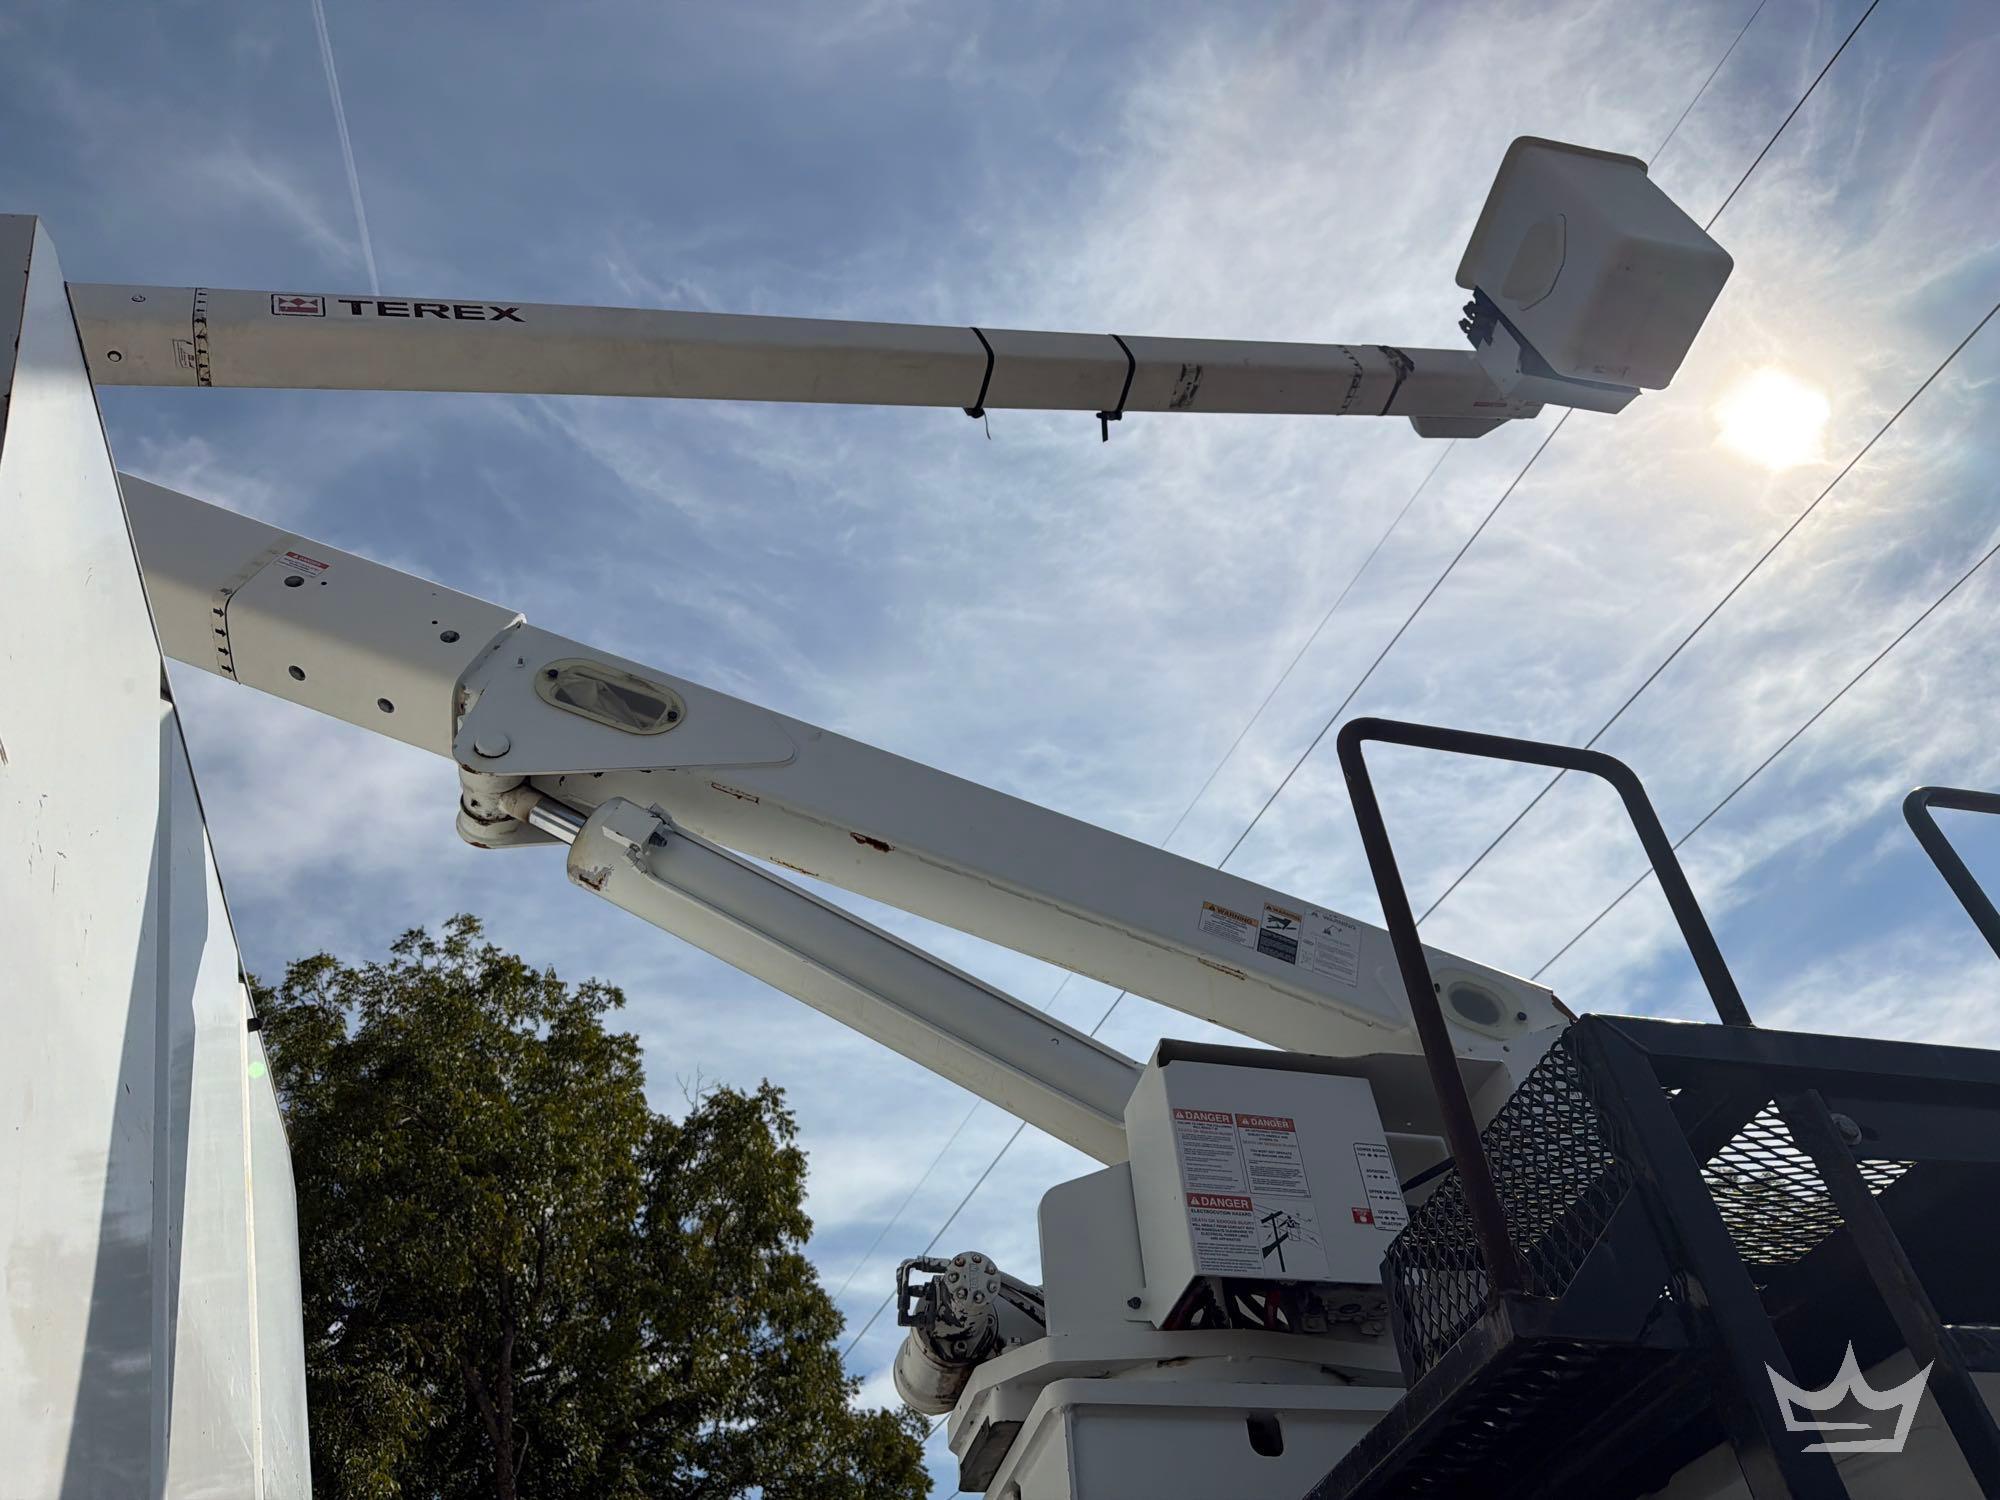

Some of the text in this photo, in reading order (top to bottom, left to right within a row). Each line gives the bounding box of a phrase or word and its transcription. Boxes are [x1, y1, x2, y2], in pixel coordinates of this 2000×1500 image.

[338, 299, 526, 322] TEREX
[1216, 904, 1253, 925] WARNING
[1185, 1111, 1230, 1123] DANGER
[1251, 1118, 1289, 1129] DANGER
[1200, 1196, 1250, 1209] DANGER
